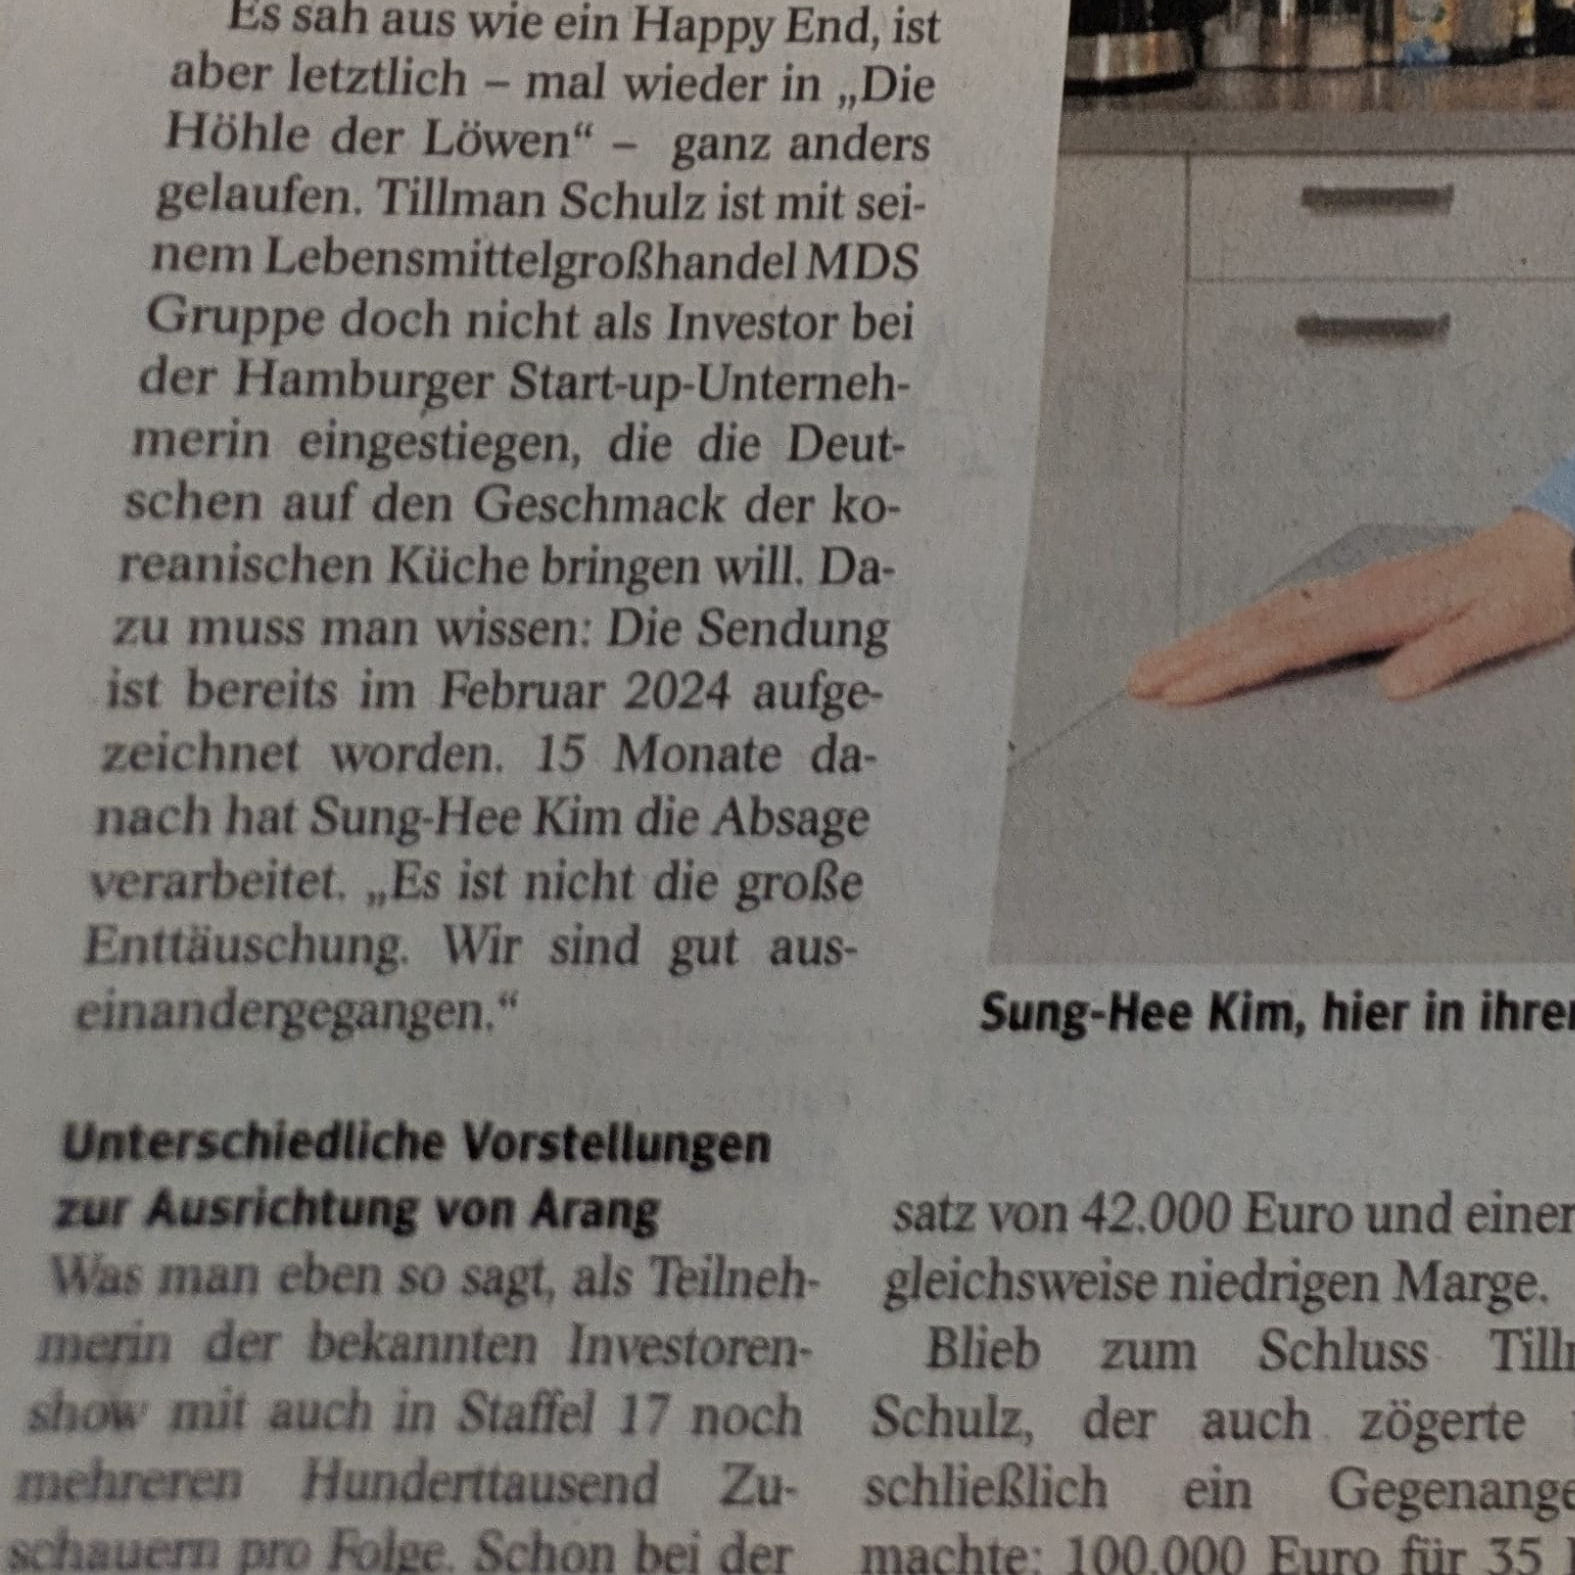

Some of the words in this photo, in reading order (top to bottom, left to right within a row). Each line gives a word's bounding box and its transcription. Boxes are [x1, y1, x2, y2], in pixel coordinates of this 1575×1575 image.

[146, 293, 325, 348] Gruppe
[340, 296, 450, 339] doch
[466, 297, 580, 341] nicht
[593, 300, 652, 341] als
[667, 302, 840, 342] Investor
[852, 300, 914, 342] bei
[107, 666, 160, 710] ist
[186, 666, 338, 710] bereits
[359, 667, 415, 710] im
[440, 668, 607, 711] Februar
[623, 669, 731, 711] 2024
[752, 667, 883, 723] aufge-
[979, 990, 1194, 1043] Sung-Hee
[1207, 988, 1306, 1039] Kim,
[1322, 988, 1411, 1033] hier
[1424, 988, 1465, 1033] in
[61, 1118, 446, 1164] Unterschiedliche
[462, 1120, 772, 1175] Vorstellungen
[53, 1196, 131, 1231] zur
[143, 1185, 421, 1239] Ausrichtung
[434, 1195, 516, 1230] von
[528, 1186, 661, 1241] Arang
[892, 1193, 977, 1234] satz
[987, 1201, 1068, 1235] von
[1080, 1190, 1232, 1235] 42.000
[1243, 1190, 1354, 1236] Euro
[1364, 1188, 1453, 1236] und
